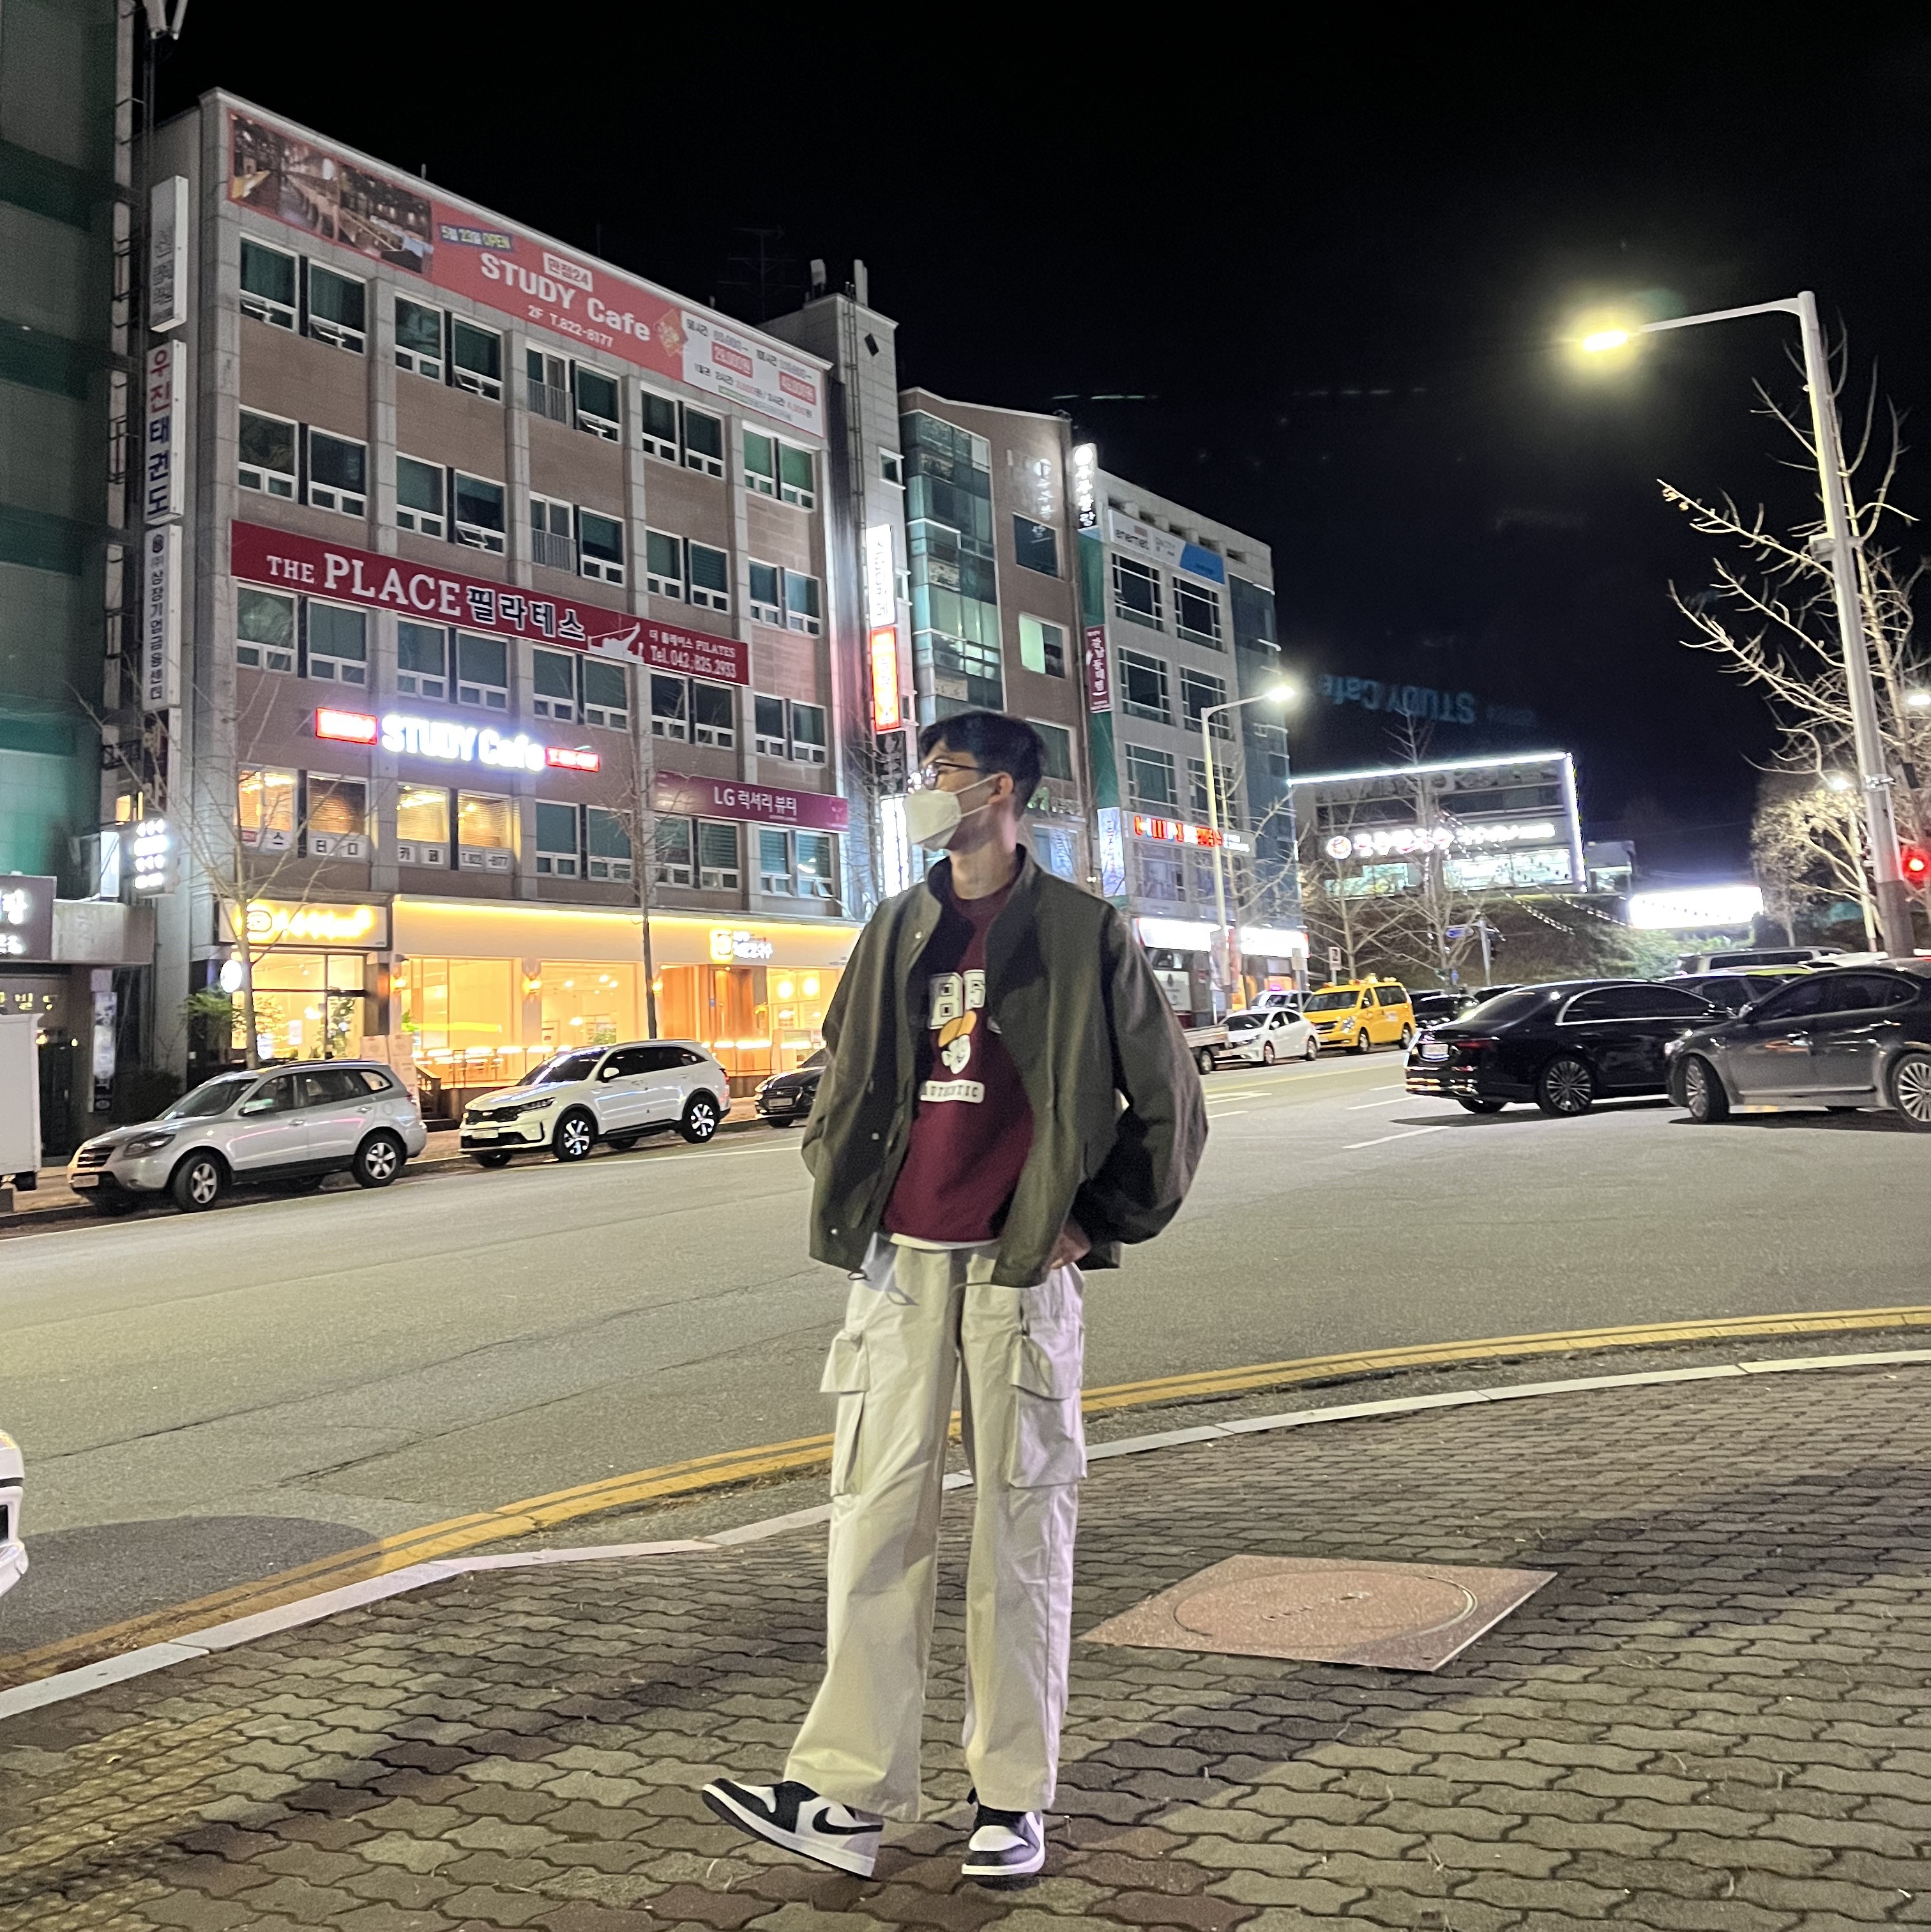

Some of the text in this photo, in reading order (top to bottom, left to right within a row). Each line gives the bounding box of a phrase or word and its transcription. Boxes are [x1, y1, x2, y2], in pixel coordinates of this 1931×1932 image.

[481, 252, 650, 341] STUDY Cafe
[527, 305, 543, 319] 2F
[267, 552, 586, 641] THE PLACE 필라테스
[382, 713, 477, 761] STUDY
[478, 729, 546, 772] Cafe
[714, 786, 735, 807] LG
